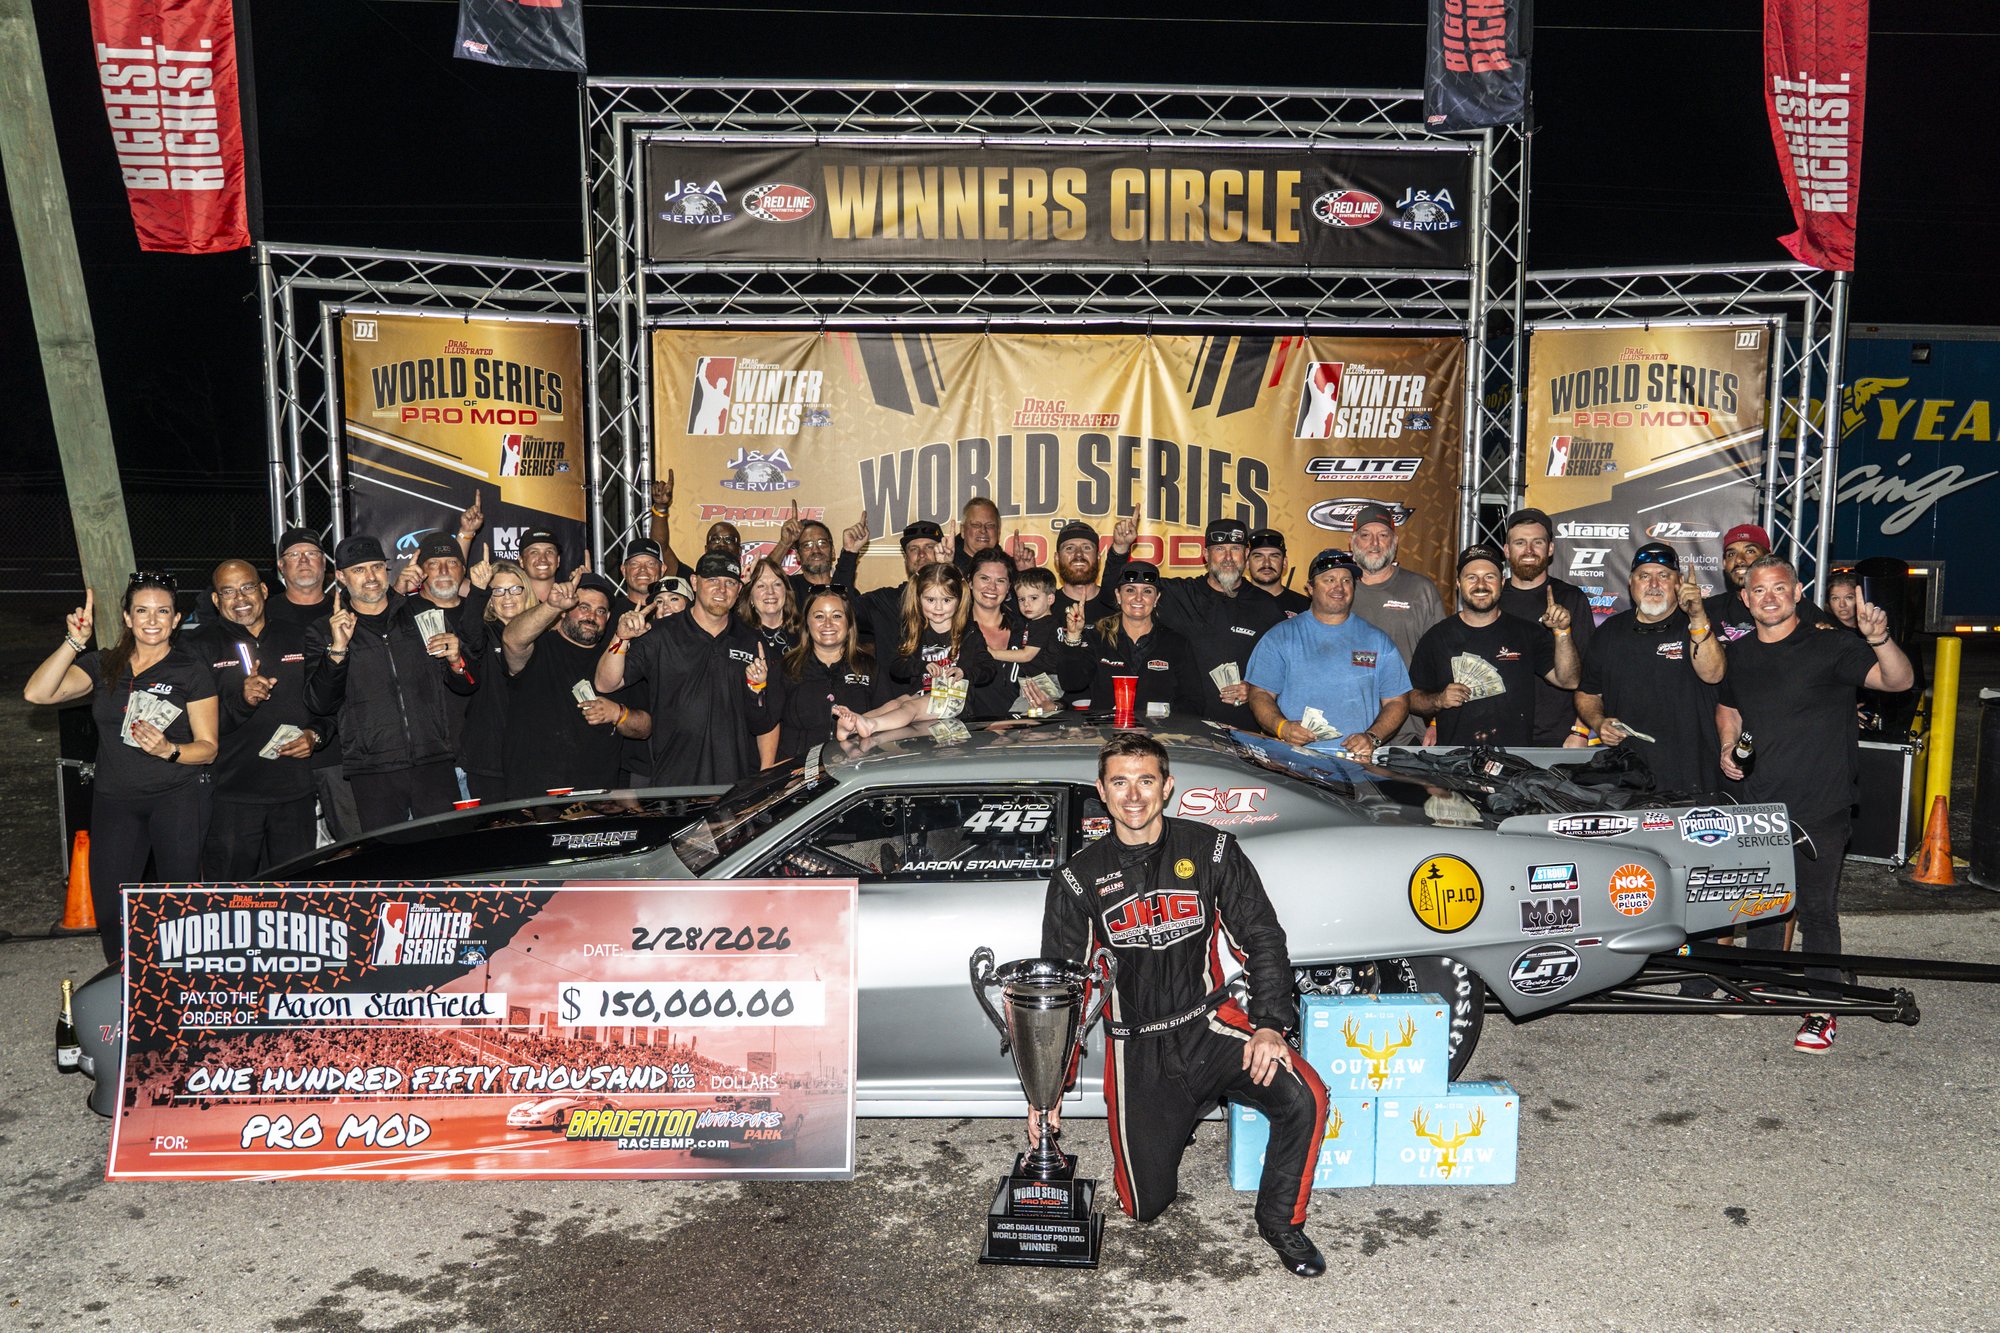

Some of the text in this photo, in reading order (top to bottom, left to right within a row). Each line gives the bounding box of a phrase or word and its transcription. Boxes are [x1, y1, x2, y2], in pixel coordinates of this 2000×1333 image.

[97, 37, 169, 189] BIGGEST.
[156, 39, 224, 190] RICHEST.
[1808, 73, 1850, 213] RICHEST.
[665, 179, 728, 203] J&A
[1396, 187, 1455, 210] J&A
[763, 196, 785, 208] RED
[823, 165, 1301, 243] WINNERS CIRCLE
[1333, 202, 1353, 214] RED
[662, 213, 732, 224] SERVICE
[1392, 219, 1459, 230] SERVICE
[356, 324, 375, 338] DI
[447, 340, 468, 349] DRAG
[1738, 332, 1758, 347] DI
[444, 346, 493, 356] ILLUSTRATED
[1620, 353, 1669, 361] ILLUSTRATED
[1624, 347, 1644, 356] DRAG
[371, 357, 564, 414] WORLD SERIES
[736, 370, 823, 403] WINTER
[1341, 375, 1426, 407] WINTER
[1551, 363, 1739, 416] WORLD SERIES
[1023, 398, 1066, 413] DRAG
[401, 407, 538, 425] PRO MOD
[729, 403, 803, 436] SERIES
[1012, 411, 1121, 428] ILLUSTRATED
[1334, 408, 1405, 439] SERIES
[1573, 411, 1710, 429] PRO MOD
[522, 441, 565, 459] WINTER
[727, 447, 793, 469] J&A
[1571, 442, 1614, 458] WINTER
[520, 459, 556, 477] SERIES
[1309, 459, 1417, 472] ELITE
[1567, 460, 1603, 477] SERIES
[724, 481, 798, 492] SERVICE
[858, 432, 1271, 542] WORLD SERIES
[698, 504, 825, 520] PROLINE
[727, 520, 784, 528] RACIN
[1555, 521, 1630, 539] Strange
[1650, 522, 1677, 538] P2
[1177, 787, 1266, 817] S&T
[963, 811, 1051, 833] 445
[1548, 819, 1595, 832] EAST
[1598, 817, 1638, 829] SIDE
[1734, 812, 1789, 836] PSS
[552, 831, 637, 846] PROLINE
[568, 841, 620, 849] RACING
[1738, 835, 1790, 848] SERVICES
[901, 859, 1054, 871] AARON STANFIELD
[1062, 867, 1084, 896] sparco
[1537, 868, 1567, 880] STROUD
[1687, 867, 1770, 885] SCOTT
[1615, 875, 1648, 890] NGK
[233, 895, 253, 903] DRAG
[1686, 883, 1792, 902] TIDWELL
[229, 900, 278, 908] ILLUSTRATED
[1618, 900, 1648, 908] PLUGS
[1729, 892, 1795, 923] Racing
[1109, 894, 1199, 932] JHG
[408, 912, 473, 939] WINTER
[1152, 917, 1203, 934] HORSEPOWERED
[159, 910, 348, 961] WORLD SERIES
[583, 926, 792, 958] DATE: 2/28/2026
[1126, 928, 1189, 945] GARAGE
[403, 939, 457, 965] SERIES
[460, 945, 487, 956] J&A
[186, 957, 322, 973] PRO MOD
[1511, 956, 1577, 980] LAT
[1516, 978, 1550, 988] Racing
[180, 991, 258, 1005] PAY TO THE
[274, 993, 495, 1018] Aaron Stanfield
[562, 986, 795, 1023] $ 150,000.00
[183, 1012, 259, 1025] ORDER OF:
[1140, 1004, 1206, 1034] AARON STANFIELD
[1331, 1059, 1426, 1075] OUTLAW
[187, 1064, 669, 1093] ONE HUNDRED FIFTY THOUSAND
[711, 1074, 778, 1090] DOLLARS
[1350, 1077, 1406, 1091] LIGHT
[155, 1114, 432, 1150] FOR: PRO MOD
[565, 1109, 783, 1142] BRADENTON MOTORSPORTS
[743, 1129, 783, 1140] PARK
[618, 1138, 730, 1150] RACEBMP.com
[1400, 1147, 1495, 1163] OUTLAW
[1418, 1165, 1474, 1180] LIGHT
[1014, 1187, 1068, 1201] WORLD SERIES
[1035, 1225, 1080, 1233] ILLUSTRATED
[1053, 1234, 1068, 1242] PRO
[1019, 1242, 1058, 1252] WINNER
